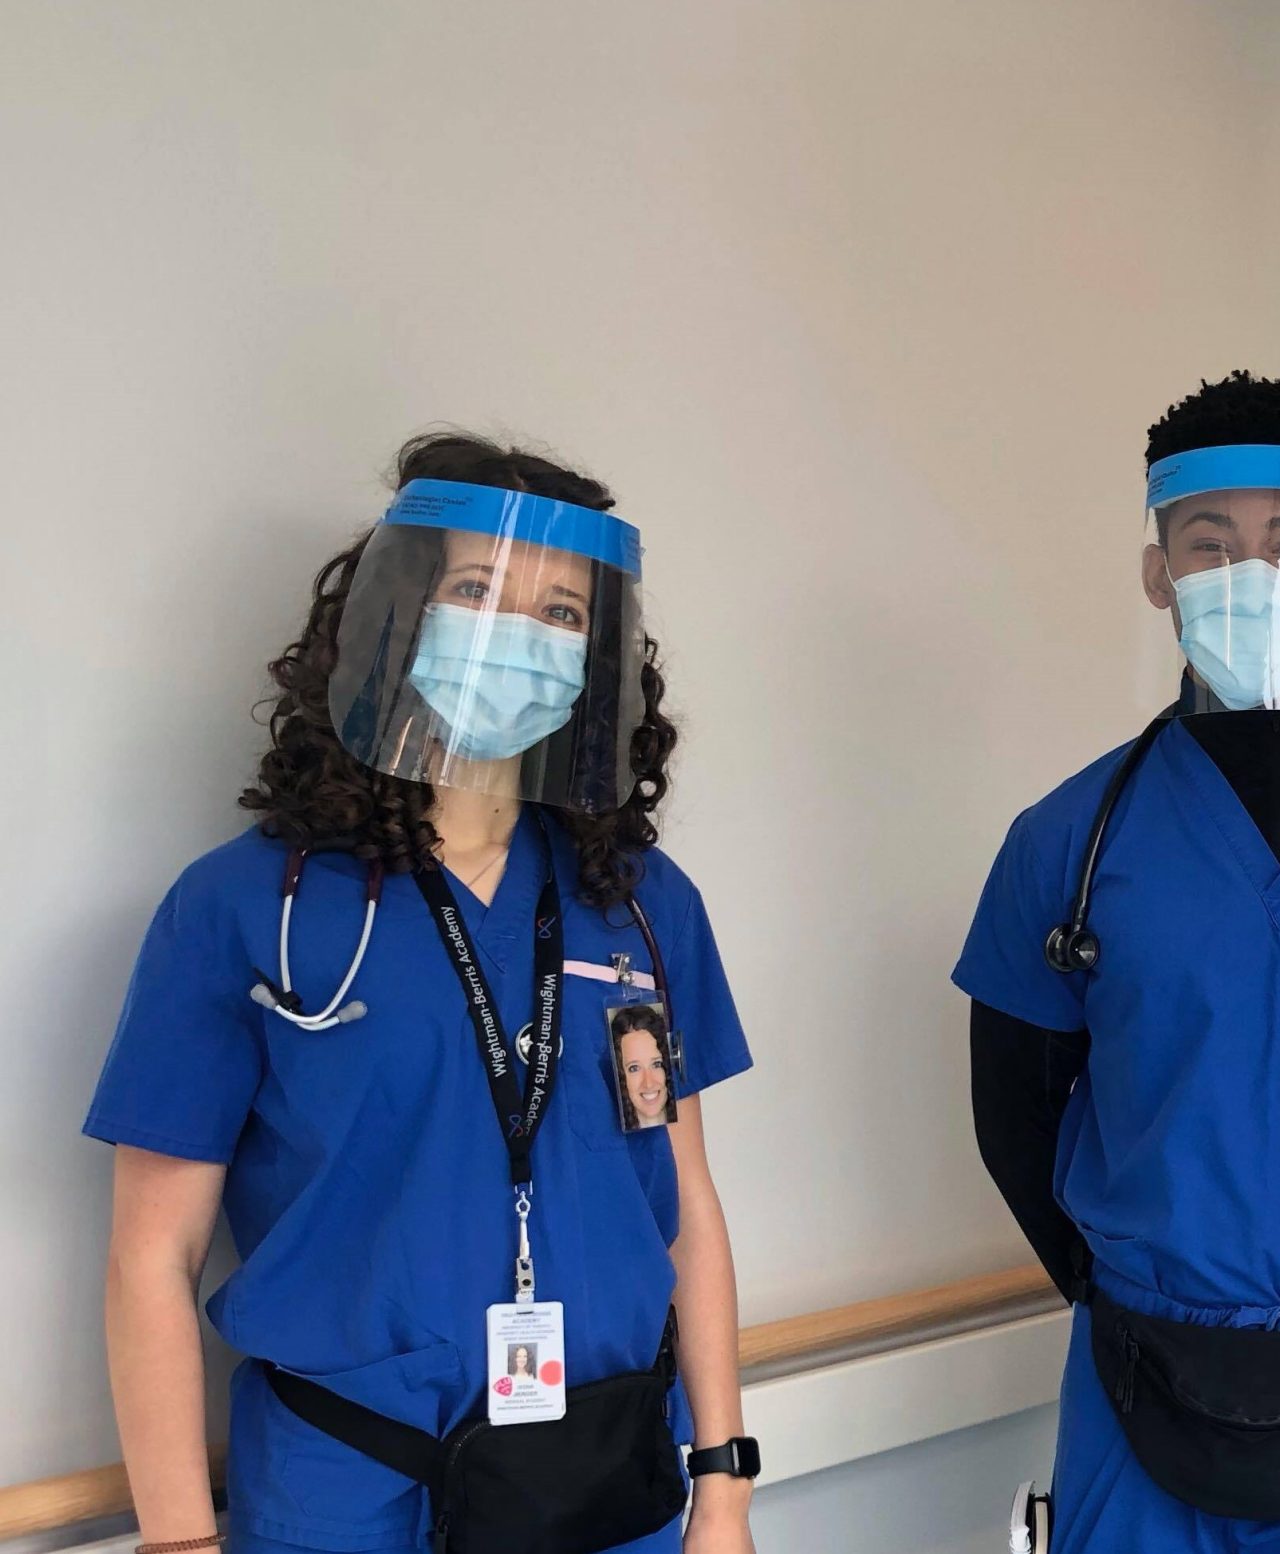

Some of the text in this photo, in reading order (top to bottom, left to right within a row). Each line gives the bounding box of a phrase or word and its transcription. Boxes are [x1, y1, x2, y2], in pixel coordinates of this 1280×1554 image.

[441, 906, 507, 1077] Wightman-Berris Academy
[532, 973, 557, 1084] Wightman-Berris
